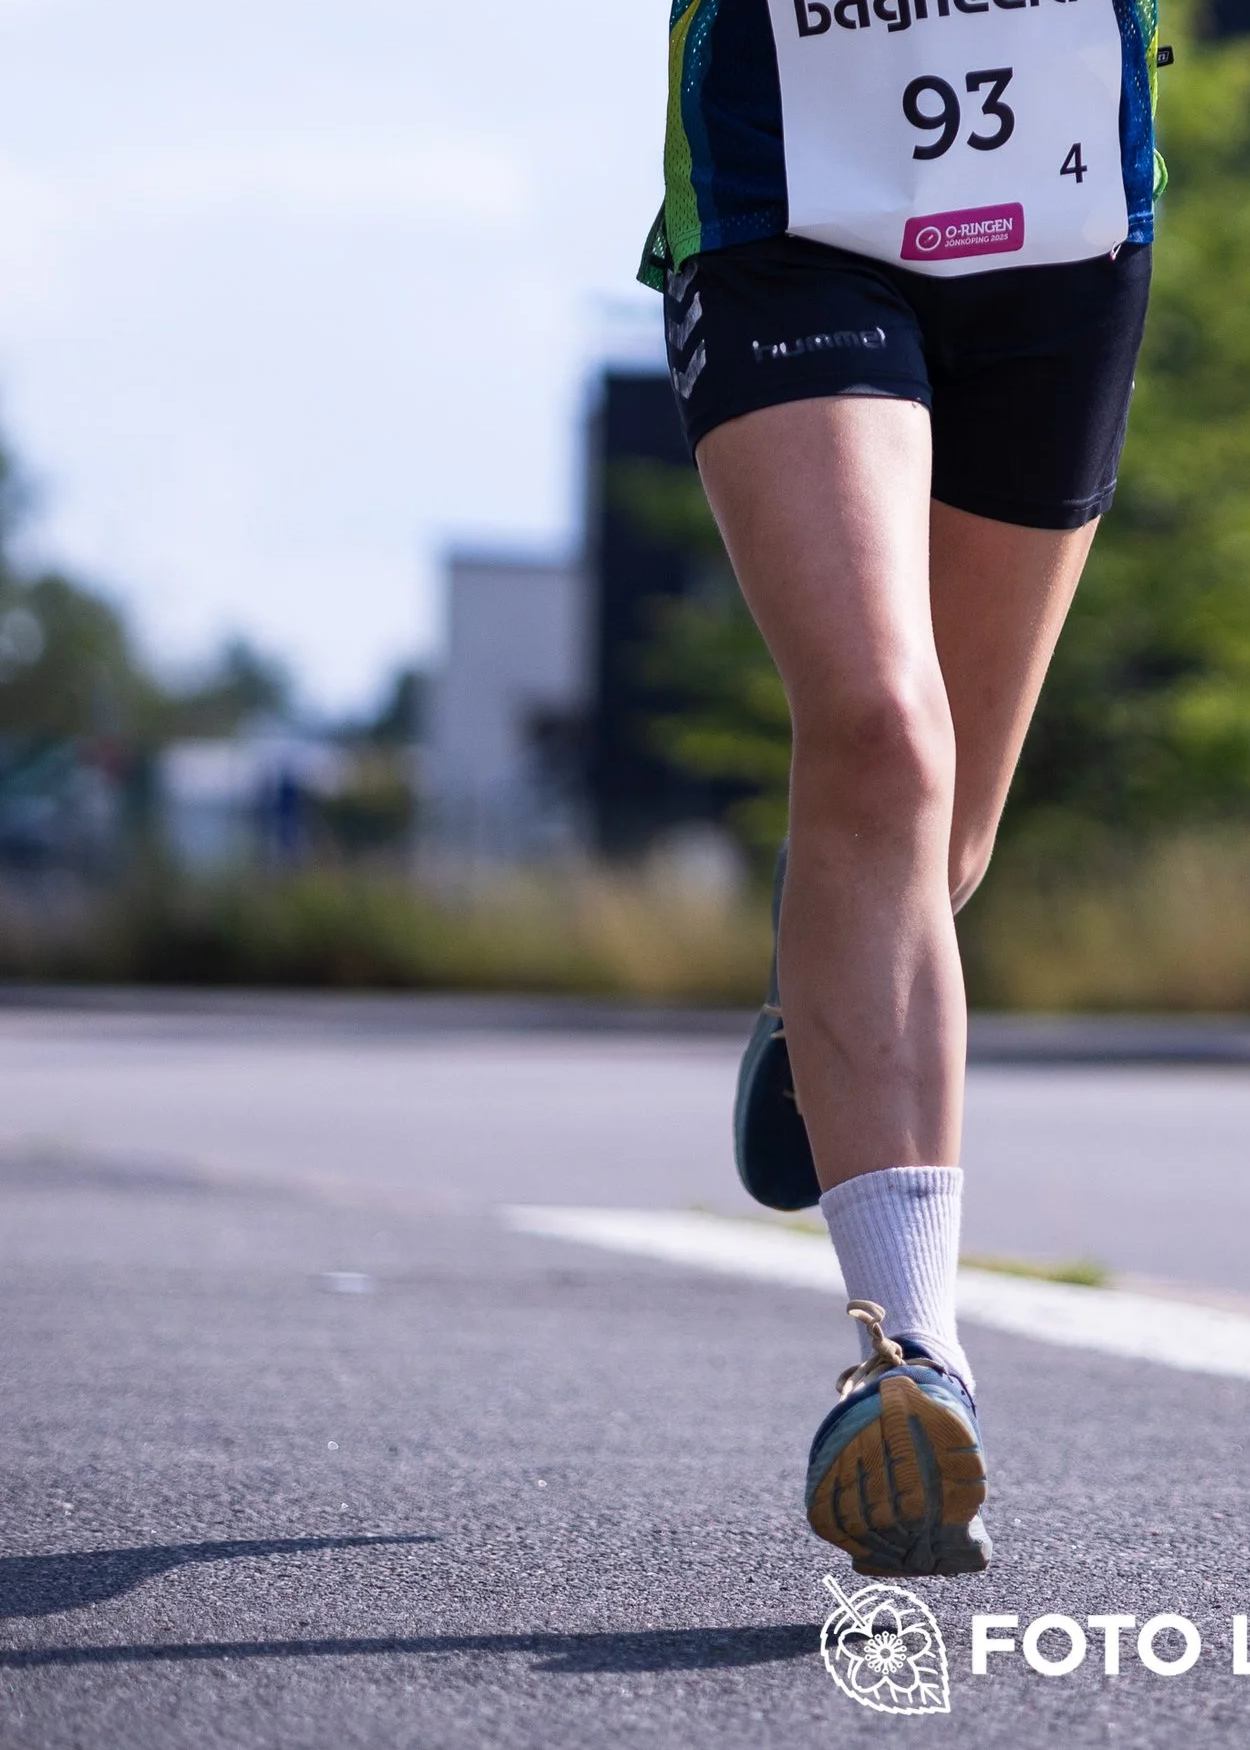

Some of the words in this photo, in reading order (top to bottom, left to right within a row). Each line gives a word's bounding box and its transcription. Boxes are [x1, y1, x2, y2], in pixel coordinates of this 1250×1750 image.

[902, 67, 1016, 160] 93
[1059, 142, 1088, 184] 4
[944, 233, 990, 248] JÖNKÖPING
[990, 233, 1009, 243] 2025
[945, 217, 1013, 239] O-RINGEN
